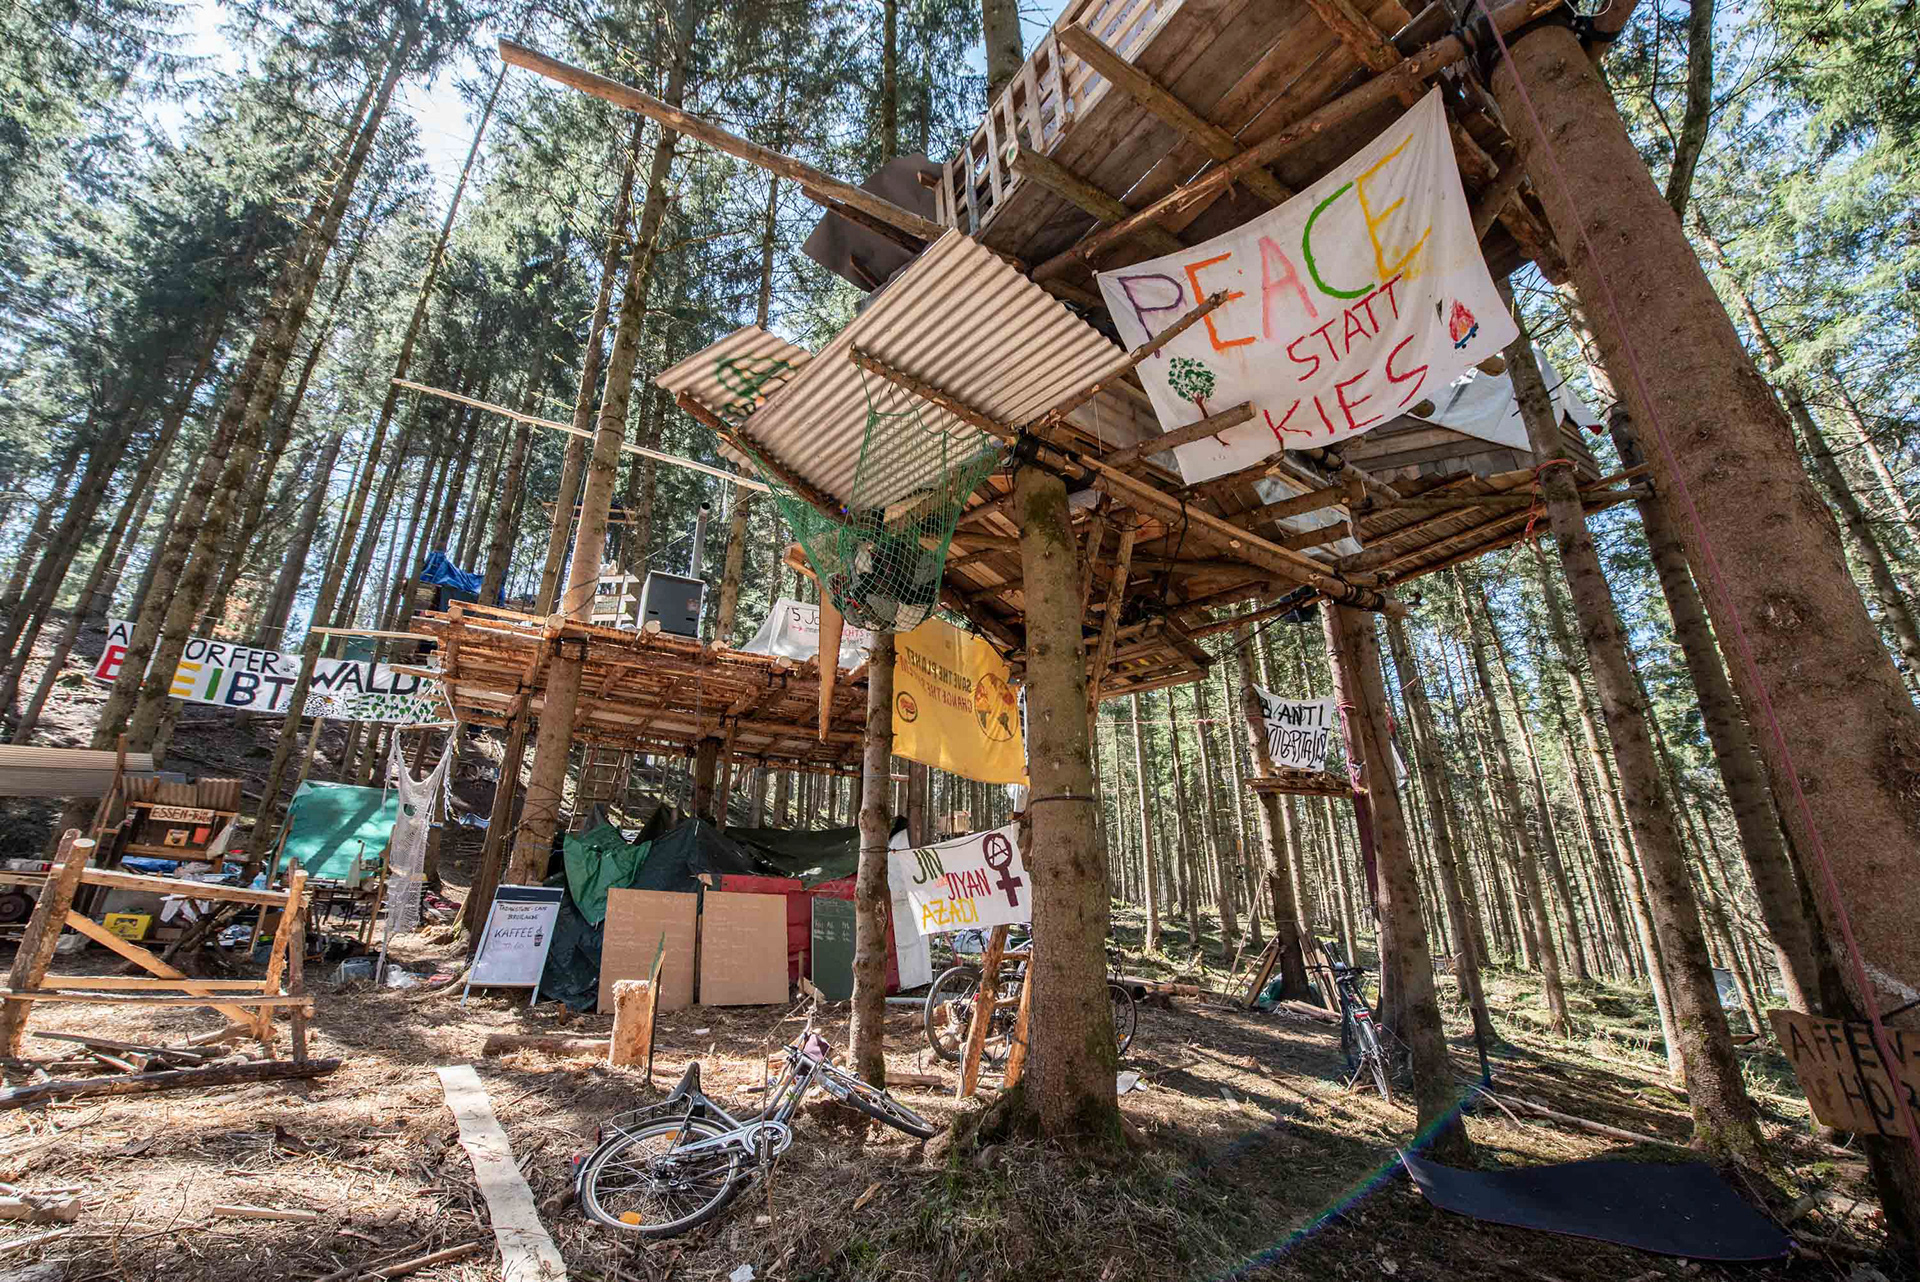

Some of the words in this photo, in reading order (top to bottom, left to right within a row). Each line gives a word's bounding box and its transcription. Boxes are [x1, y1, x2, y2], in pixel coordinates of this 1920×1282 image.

[1118, 133, 1431, 358] PEACE
[1286, 274, 1403, 381] STATT
[1263, 334, 1428, 441] KIES
[108, 623, 280, 675] AORFER
[94, 645, 296, 710] BEIBT
[309, 661, 421, 695] WALD
[912, 848, 945, 884] JIN
[945, 867, 992, 901] JIYAN
[494, 926, 534, 938] KAFFEE
[921, 897, 979, 930] AZADI
